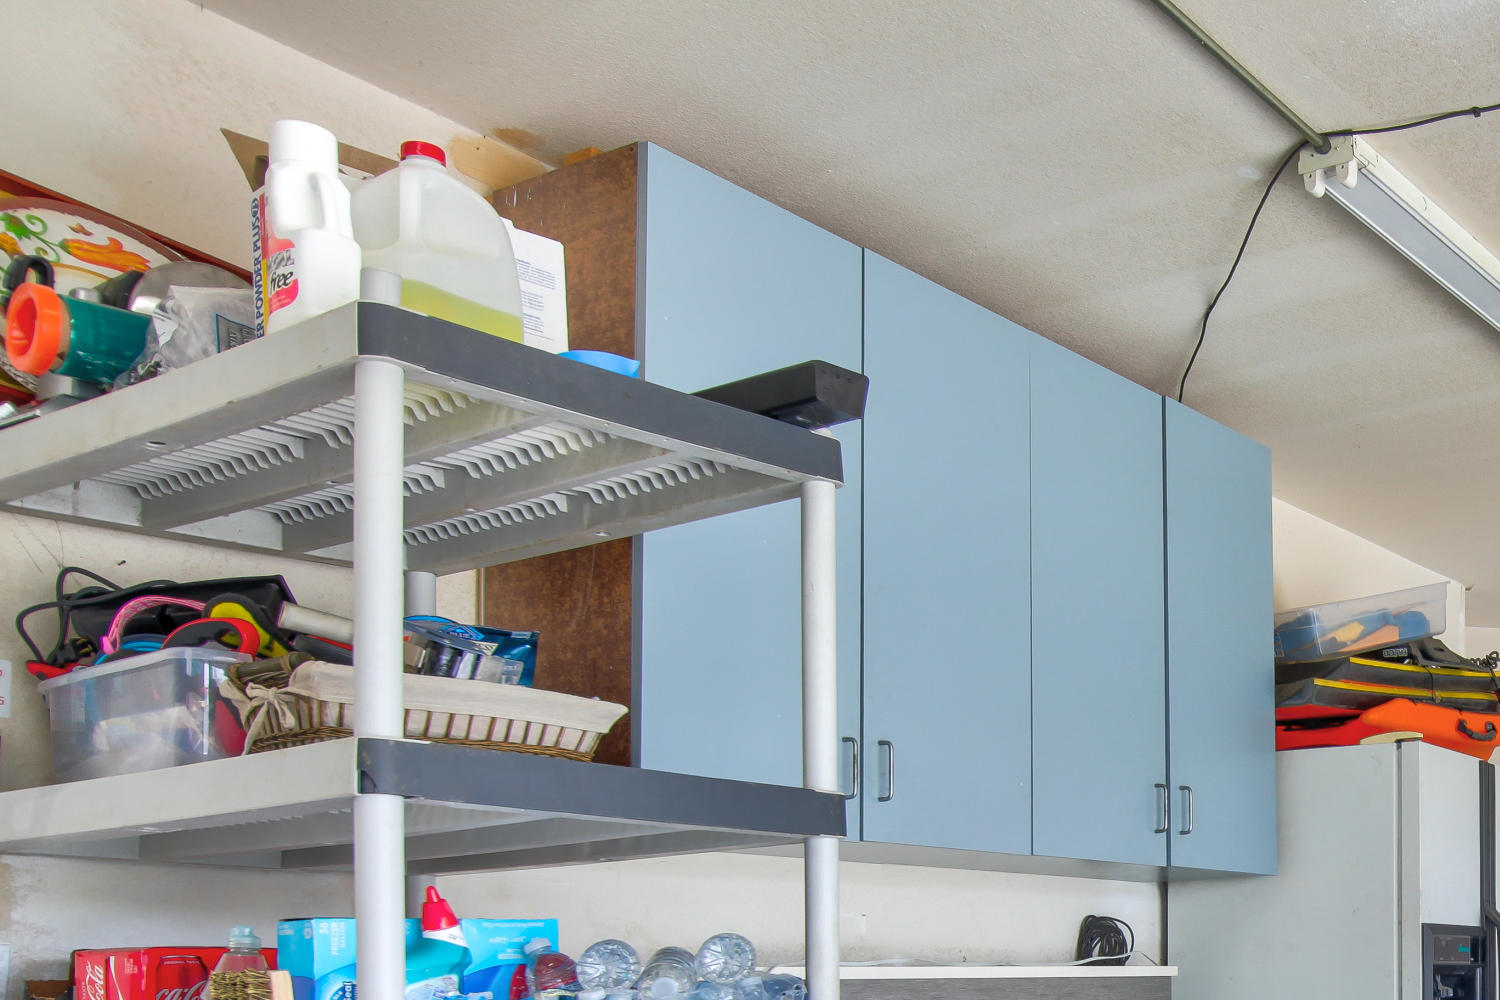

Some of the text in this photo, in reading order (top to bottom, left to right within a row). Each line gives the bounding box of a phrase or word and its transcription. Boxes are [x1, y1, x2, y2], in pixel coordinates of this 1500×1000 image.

[251, 215, 261, 254] PLUS
[253, 254, 264, 320] POWDER
[256, 321, 265, 339] ER
